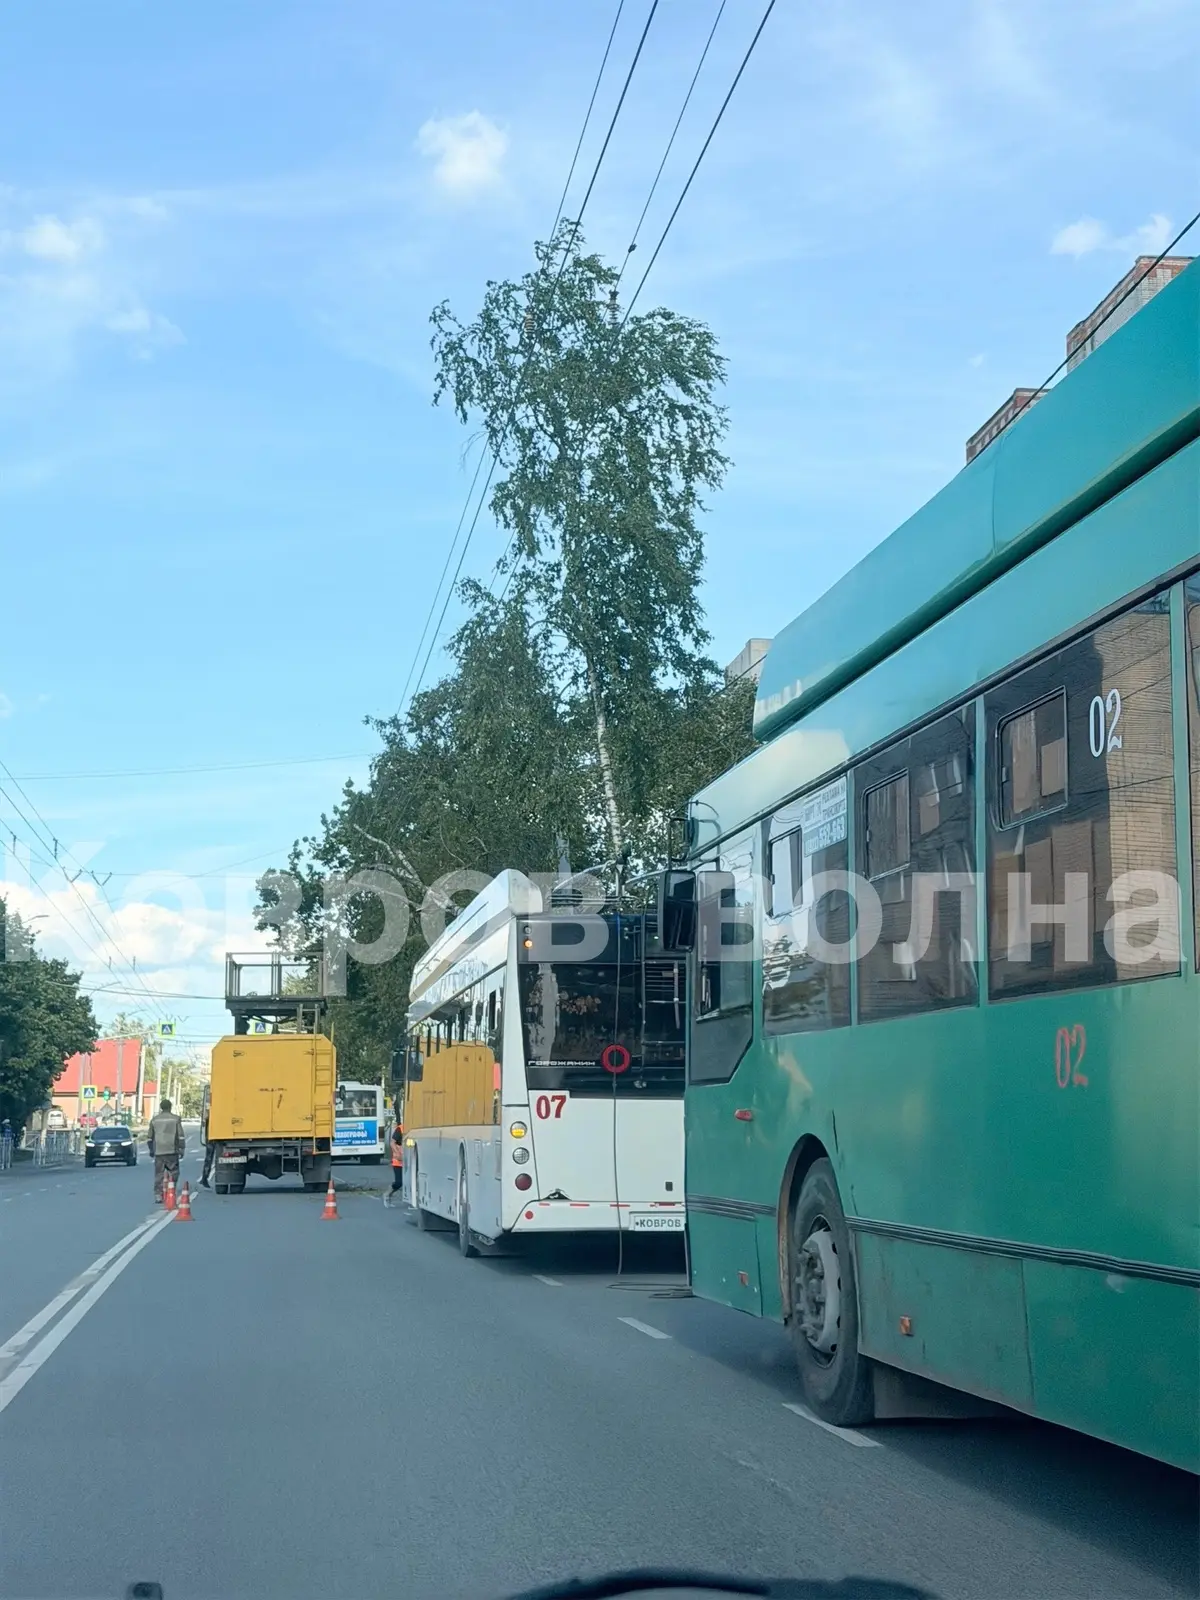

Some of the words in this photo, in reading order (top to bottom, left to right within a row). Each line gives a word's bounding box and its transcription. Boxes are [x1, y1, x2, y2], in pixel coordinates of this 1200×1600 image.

[1089, 688, 1122, 757] 02
[1056, 1024, 1088, 1088] 02
[536, 1095, 566, 1119] 07
[640, 1219, 681, 1228] КОВРОВ
